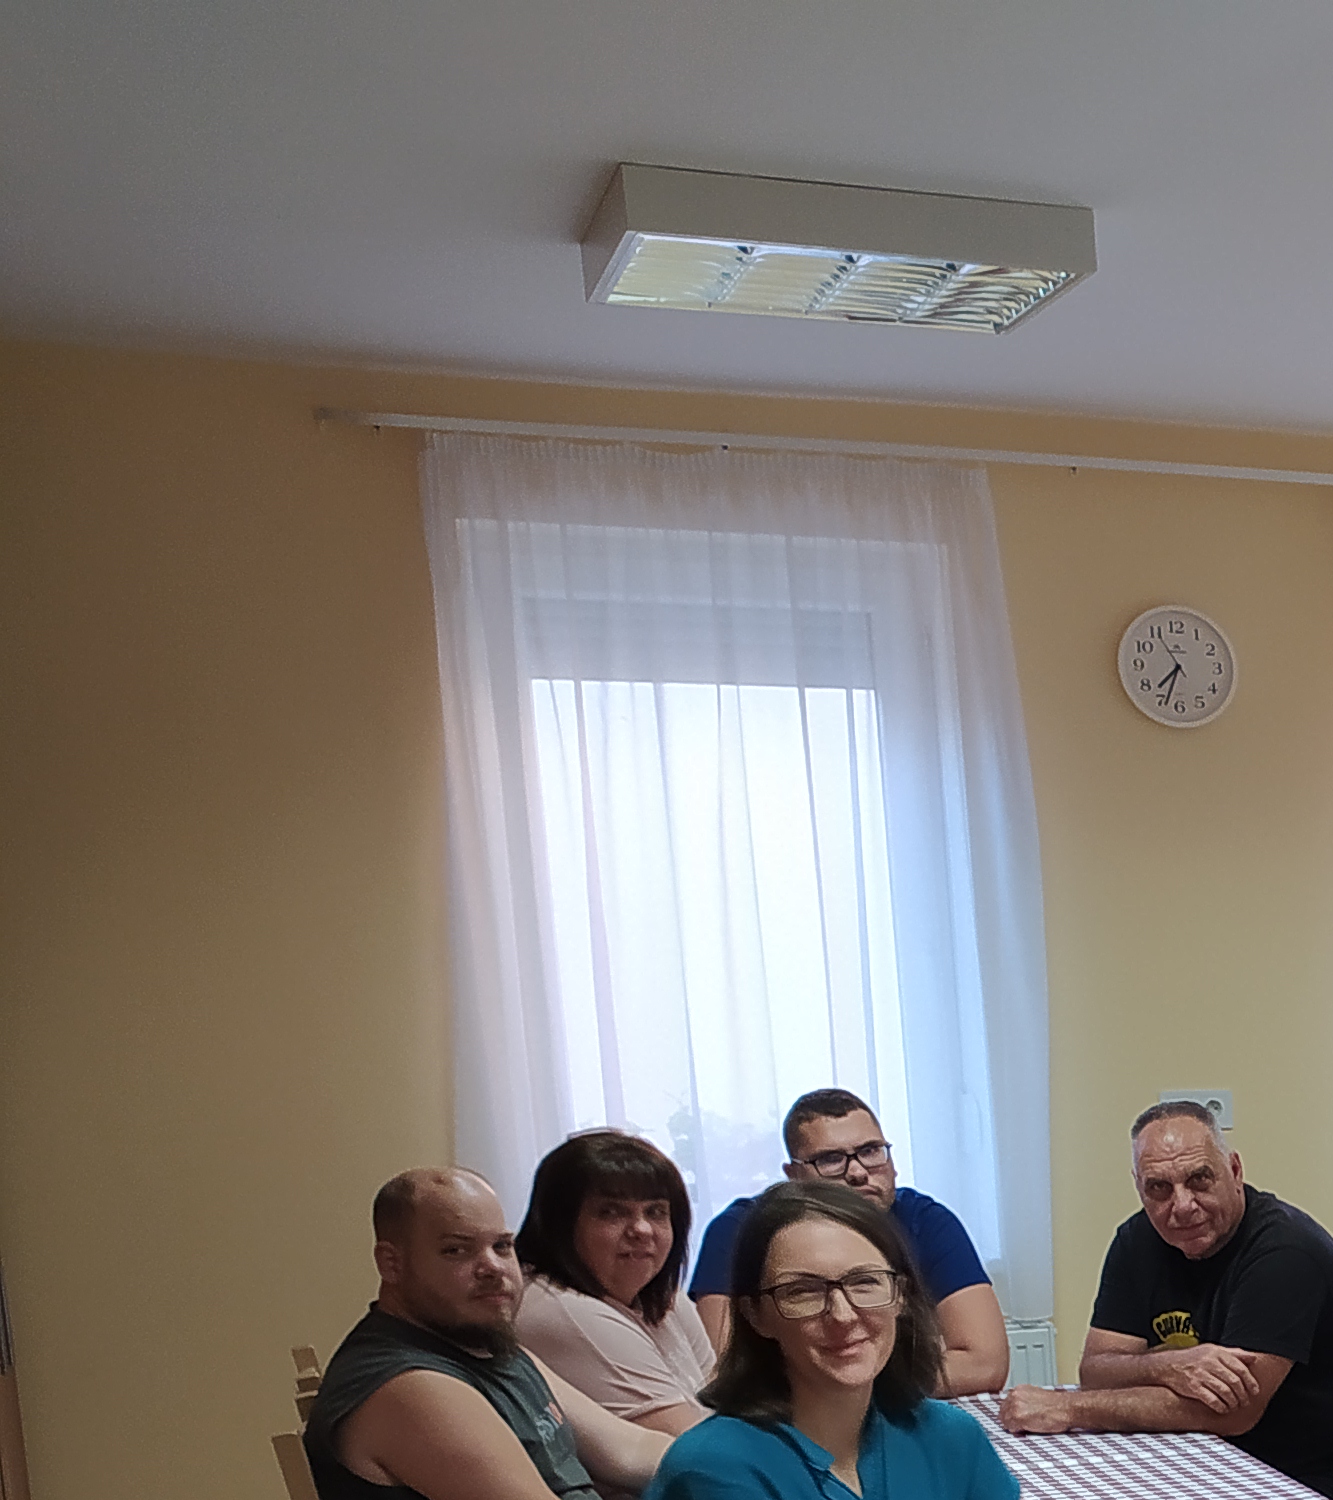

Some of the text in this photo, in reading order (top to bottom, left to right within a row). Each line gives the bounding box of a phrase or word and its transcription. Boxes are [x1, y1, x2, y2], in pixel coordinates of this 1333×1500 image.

[1149, 625, 1162, 639] 11
[1168, 620, 1185, 634] 12
[1193, 628, 1200, 641] 1
[1136, 640, 1154, 654] 10
[1205, 643, 1216, 656] 2
[1132, 658, 1145, 671] 9
[1212, 662, 1223, 675] 3
[1140, 678, 1152, 692] 8
[1207, 682, 1218, 694] 4
[1155, 694, 1166, 706] 7
[1194, 695, 1205, 709] 5
[1173, 700, 1186, 714] 6
